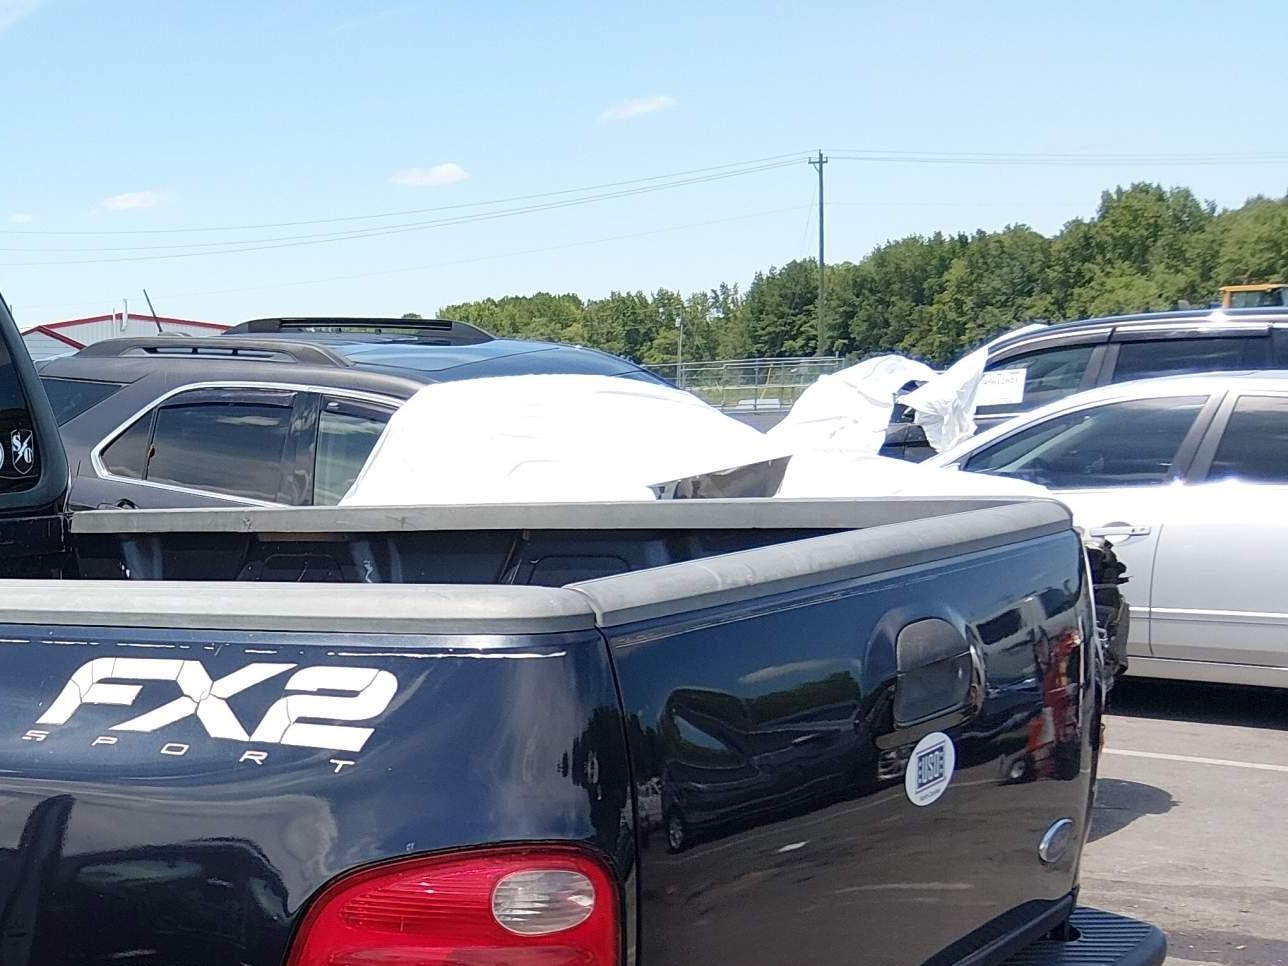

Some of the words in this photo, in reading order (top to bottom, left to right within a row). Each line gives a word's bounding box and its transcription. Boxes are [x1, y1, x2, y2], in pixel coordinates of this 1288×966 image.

[36, 657, 399, 753] FX2
[22, 730, 355, 774] SPORT
[921, 751, 940, 784] USO
